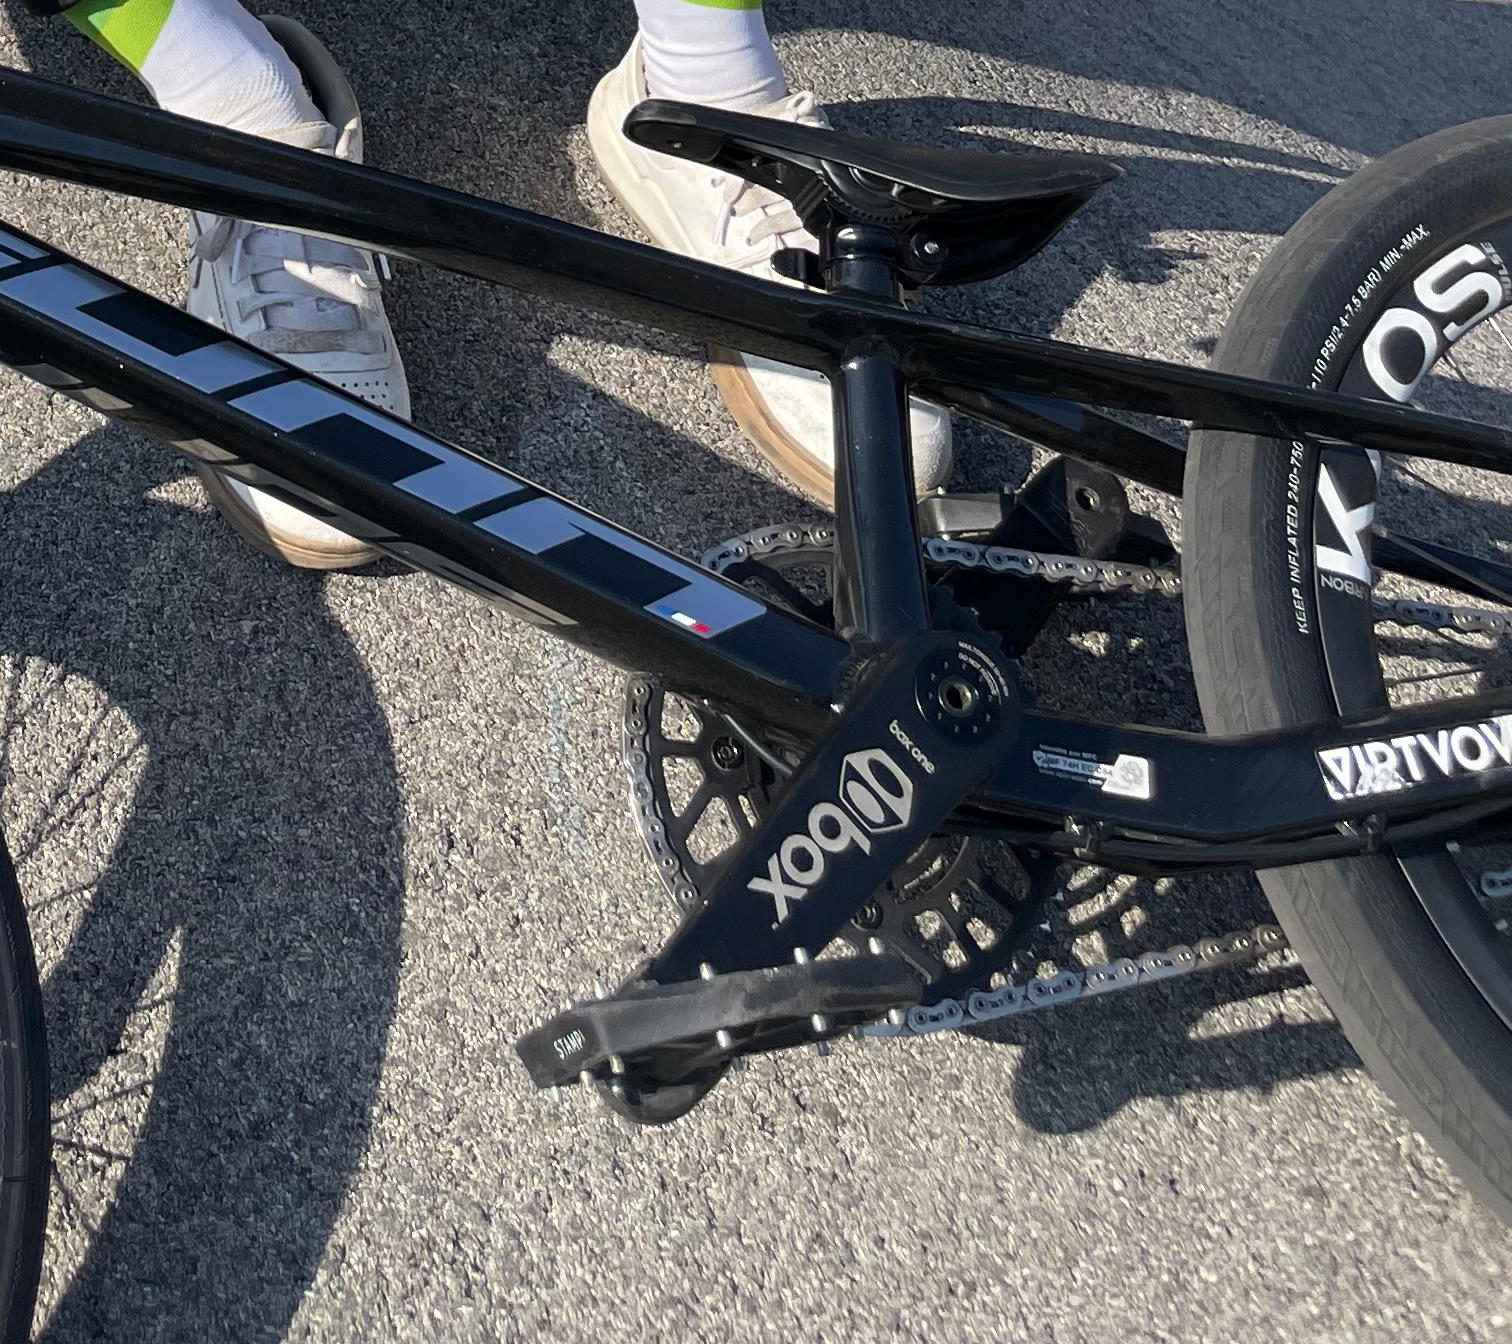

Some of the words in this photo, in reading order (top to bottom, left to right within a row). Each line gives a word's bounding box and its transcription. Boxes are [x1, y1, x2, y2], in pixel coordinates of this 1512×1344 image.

[1354, 266, 1384, 300] BAR)
[1287, 440, 1304, 502] 240-750
[1284, 504, 1303, 583] INFLATED
[1290, 586, 1310, 633] KEEP
[1317, 573, 1368, 599] RBON
[748, 801, 872, 926] box
